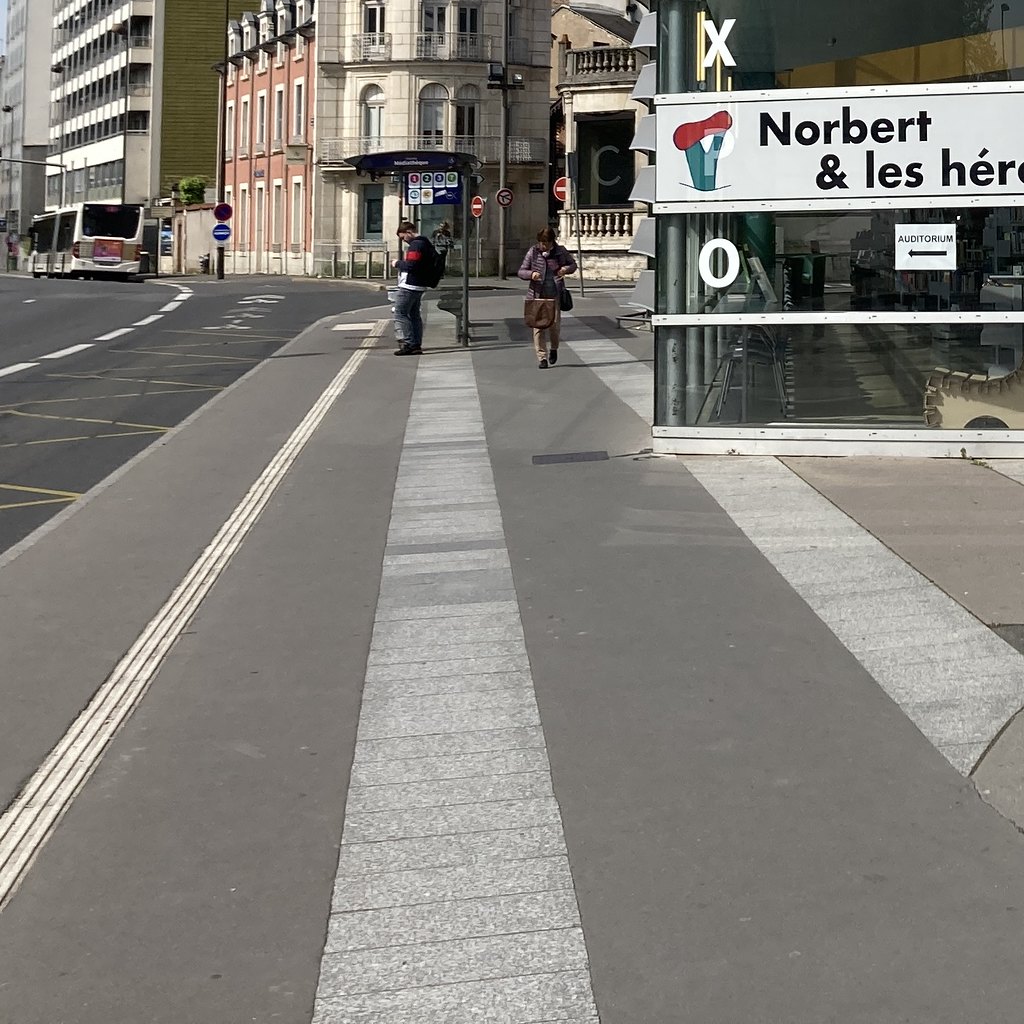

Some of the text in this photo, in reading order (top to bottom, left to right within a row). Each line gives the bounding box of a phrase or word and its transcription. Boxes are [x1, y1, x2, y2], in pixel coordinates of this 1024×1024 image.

[759, 106, 932, 147] Norbert
[815, 153, 849, 190] &
[866, 150, 923, 188] les
[898, 235, 954, 243] AUDITORIUM
